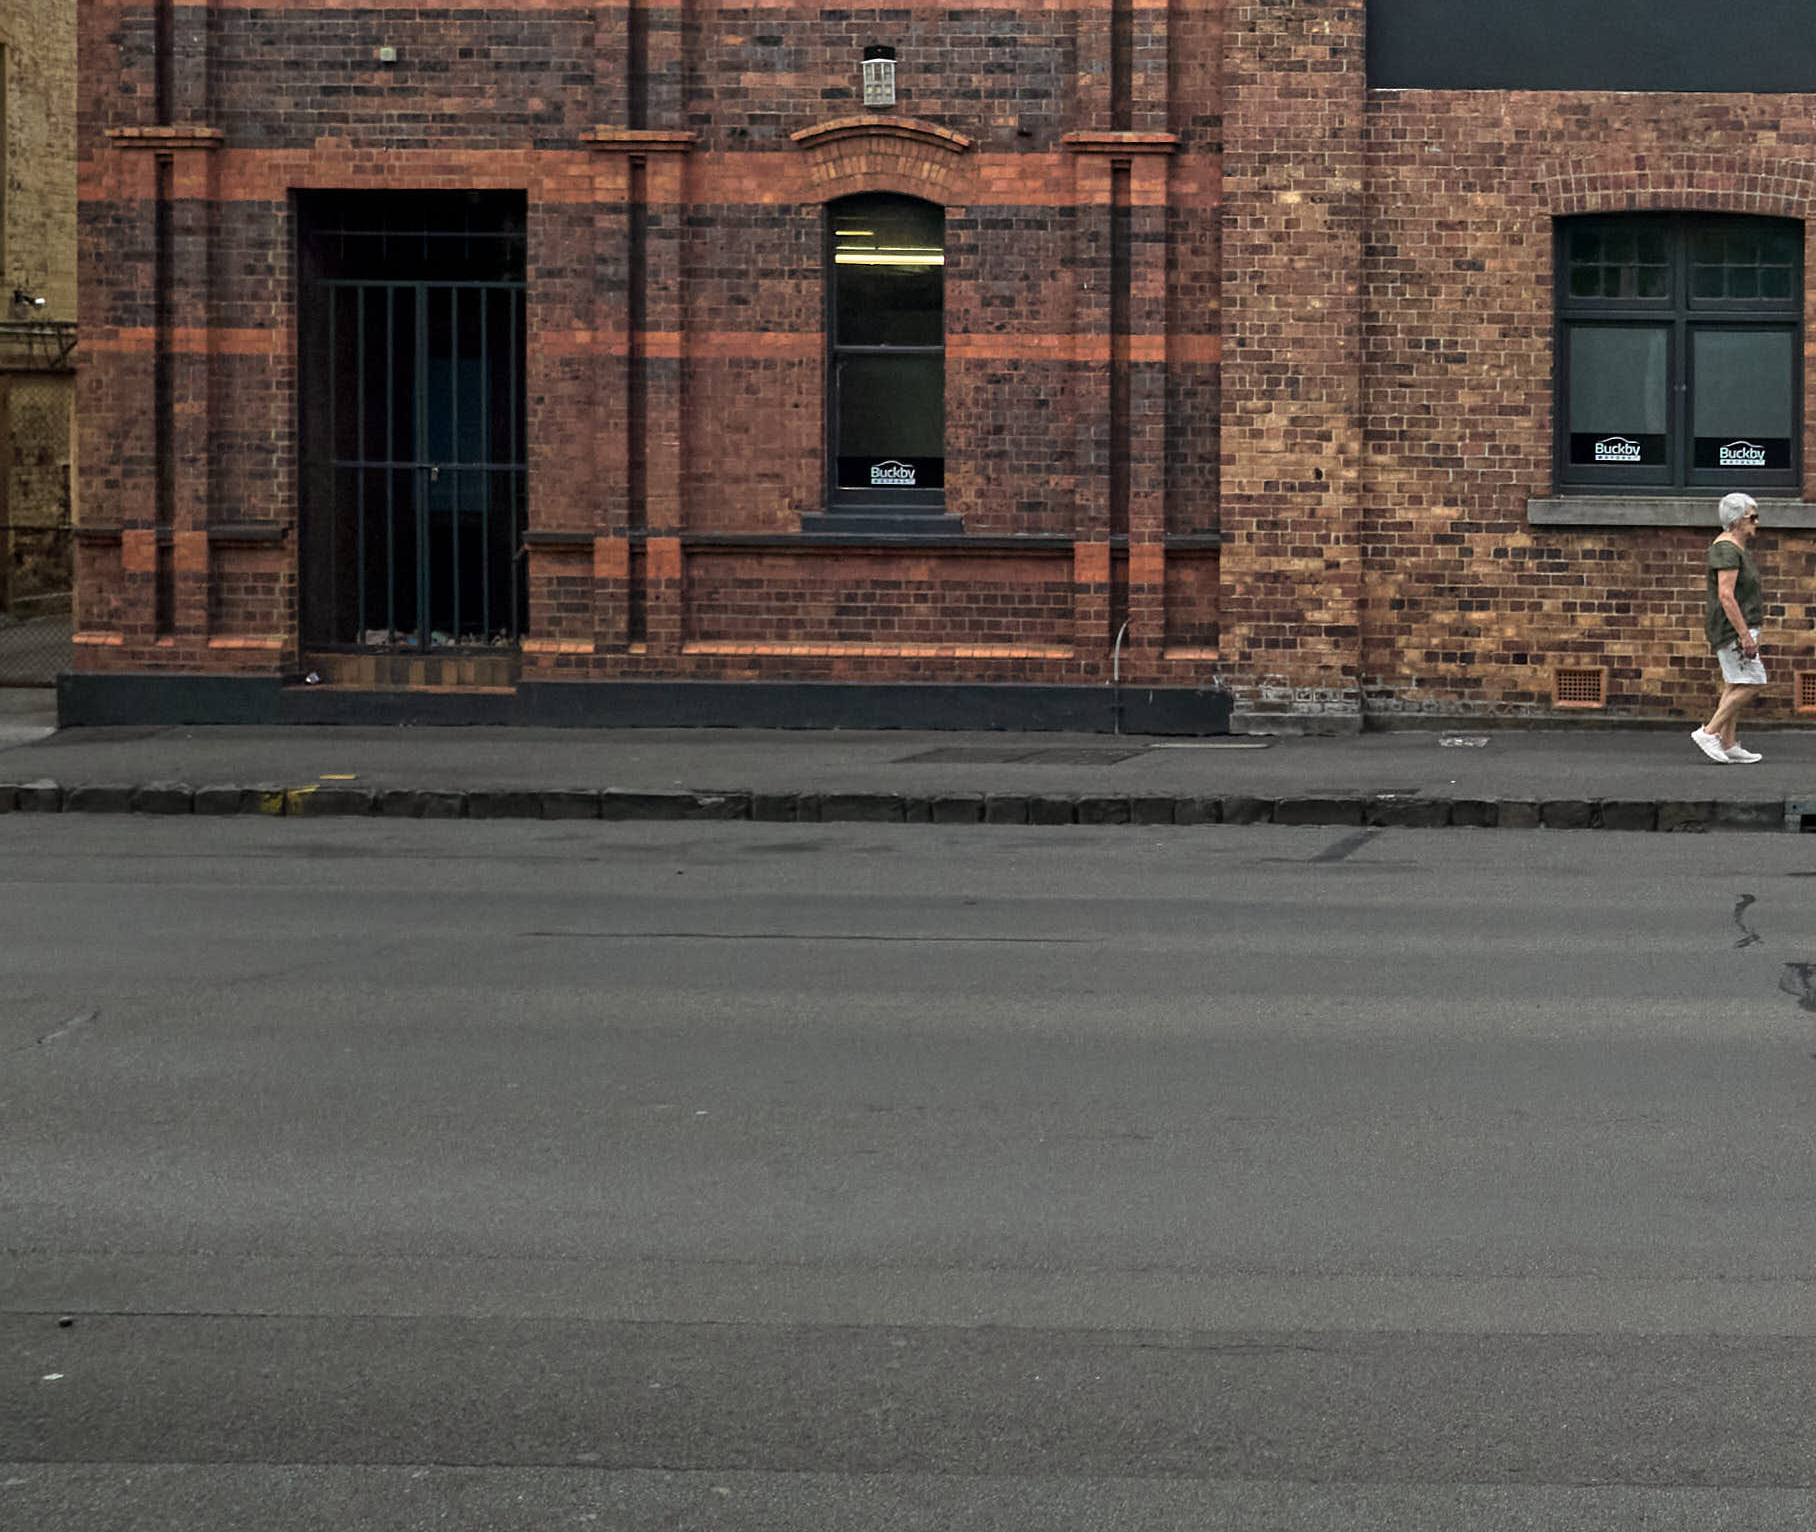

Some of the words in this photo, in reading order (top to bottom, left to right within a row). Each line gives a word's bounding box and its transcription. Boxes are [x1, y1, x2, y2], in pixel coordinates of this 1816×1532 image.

[1595, 442, 1641, 456] Buckby
[1719, 447, 1765, 460] Buckby
[871, 466, 916, 480] Buckby
